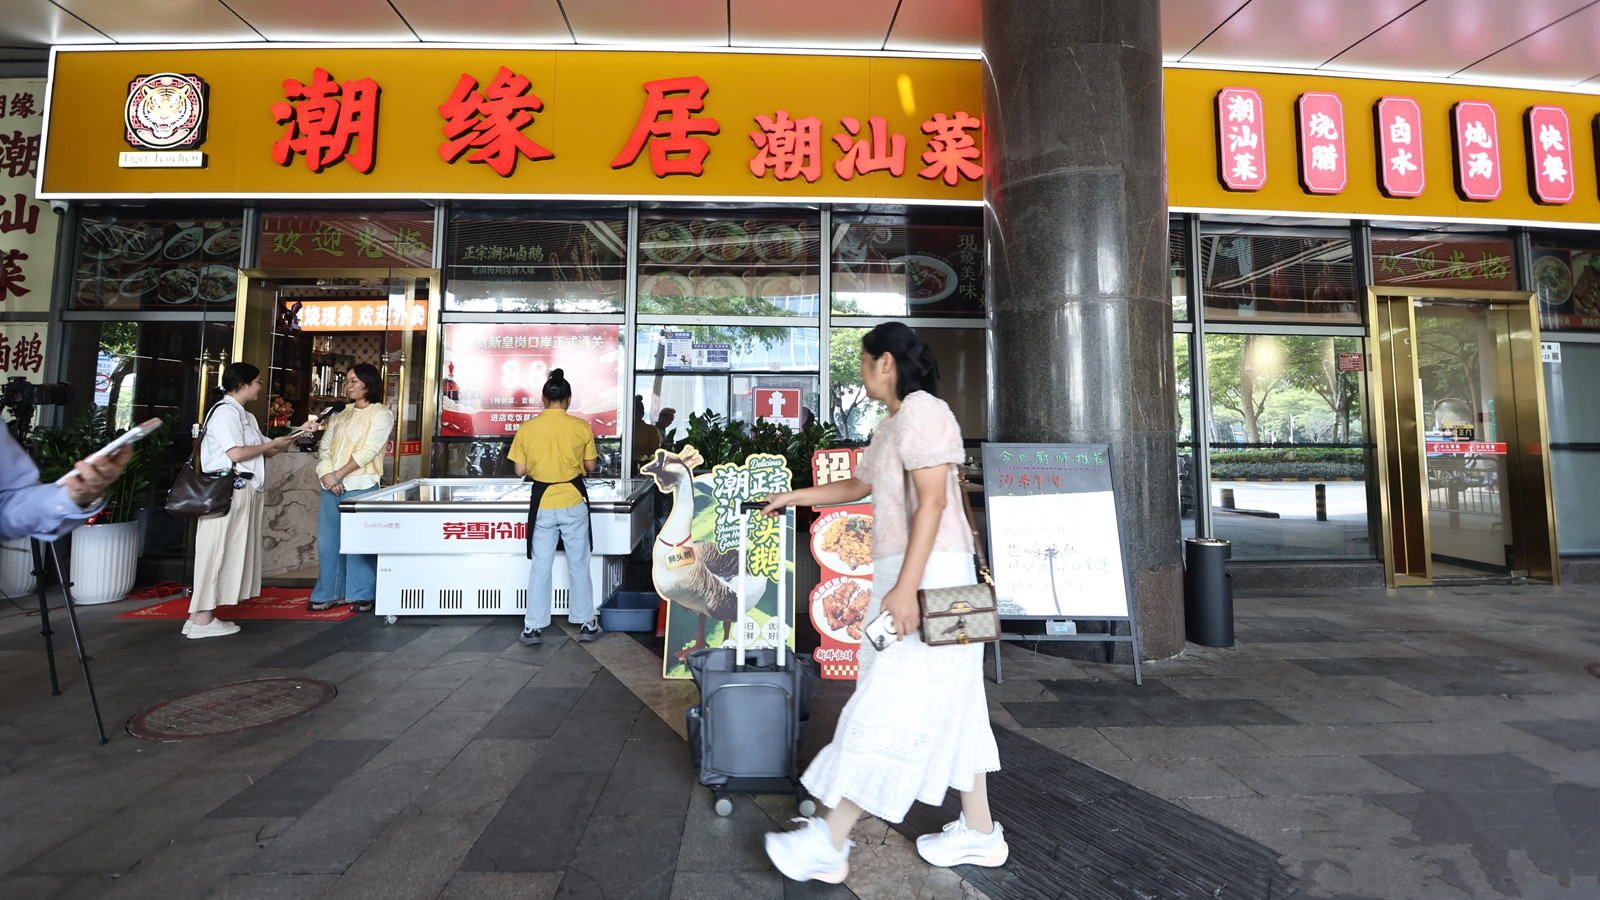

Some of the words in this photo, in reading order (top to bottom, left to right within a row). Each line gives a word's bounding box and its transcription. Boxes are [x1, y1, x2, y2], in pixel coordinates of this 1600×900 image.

[270, 66, 720, 178] 潮缘居
[749, 109, 984, 187] 潮汕菜
[1226, 94, 1259, 183] 潮汕菜
[1309, 110, 1340, 173] 烧腊
[1389, 114, 1418, 177] 卤水
[1465, 120, 1494, 180] 炖汤
[1539, 123, 1569, 184] 快餐
[272, 225, 428, 260] 欢迎光临
[461, 243, 545, 263] 正宗潮汕卤鹅
[1377, 247, 1509, 282] 欢迎光临
[296, 304, 353, 327] 烧现卖
[750, 457, 783, 470] Delicious
[750, 468, 789, 495] 正宗
[815, 450, 866, 487] 招
[719, 537, 743, 553] Goos
